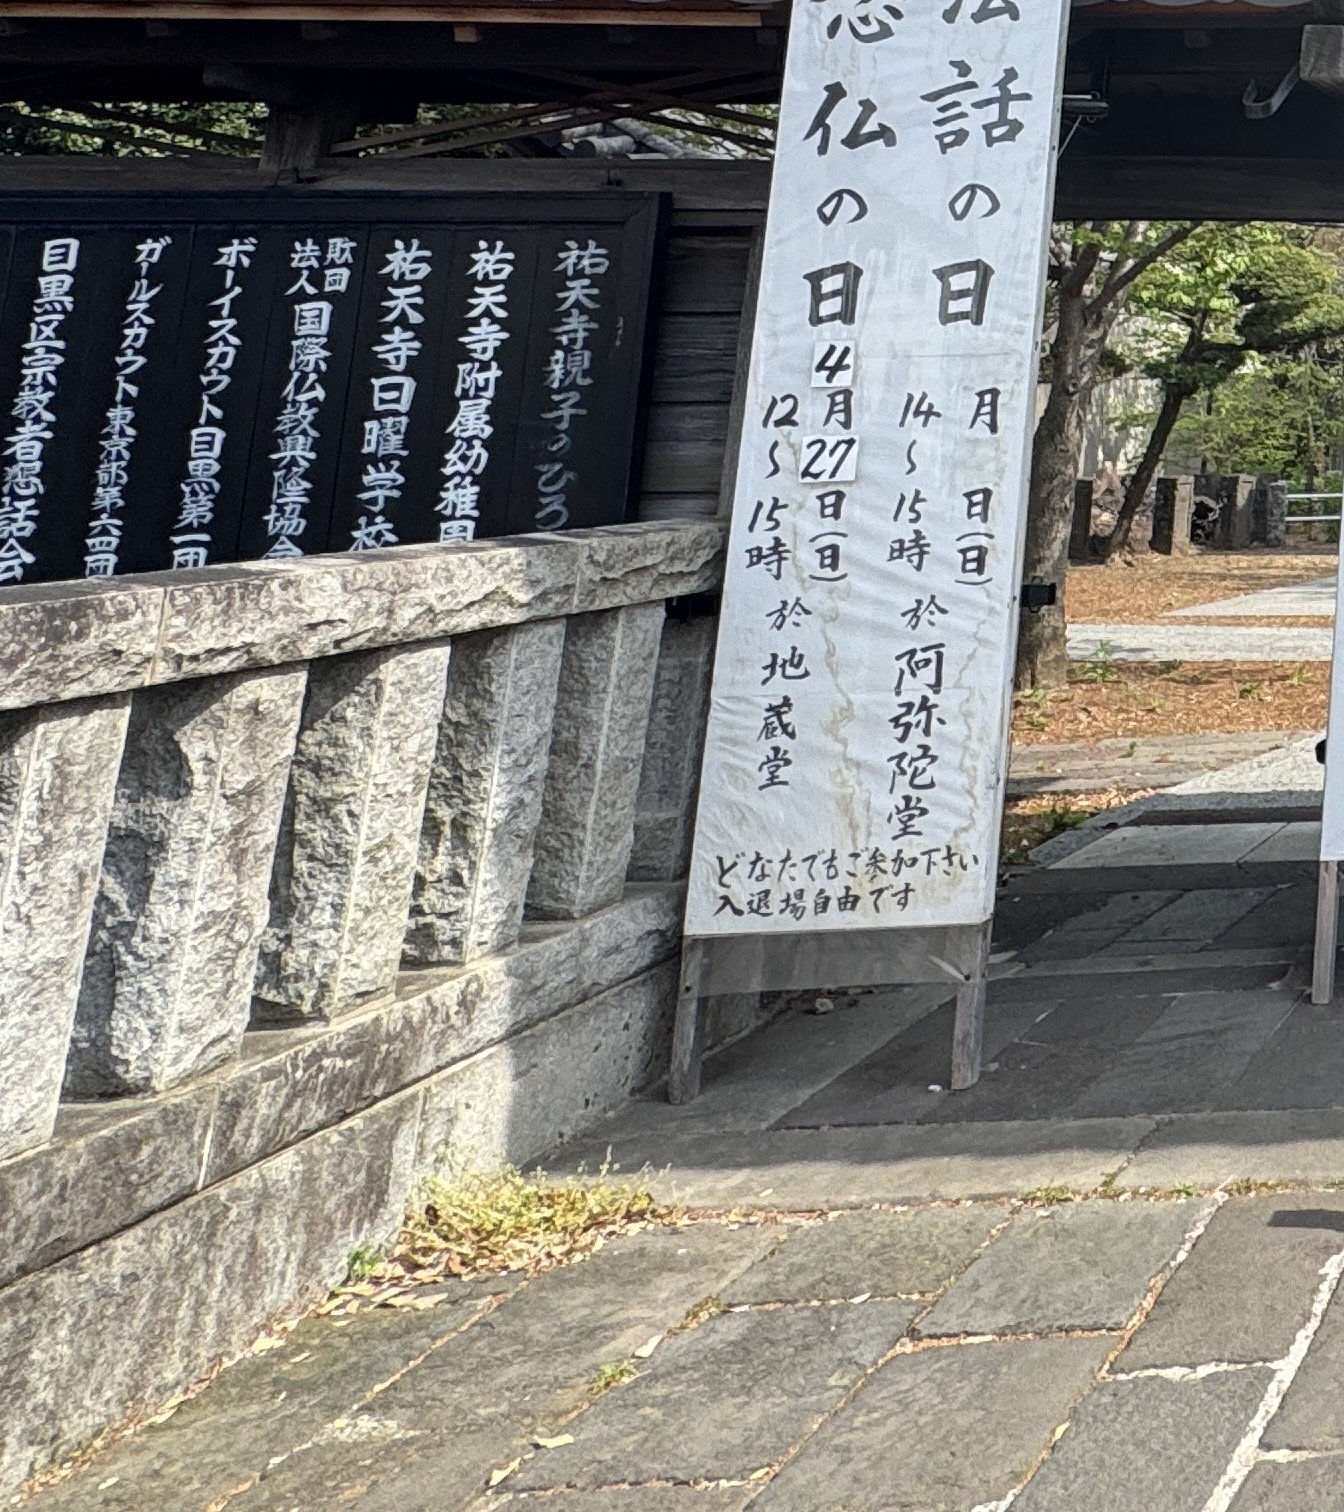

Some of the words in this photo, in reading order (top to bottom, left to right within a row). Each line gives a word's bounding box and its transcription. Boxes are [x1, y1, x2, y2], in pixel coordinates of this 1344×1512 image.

[348, 238, 433, 551] 祐天寺日曜学校
[534, 239, 610, 530] 祐天寺親子のひろ
[712, 882, 916, 921] 入退場自由です
[715, 844, 980, 888] どなたでもご参加下さい
